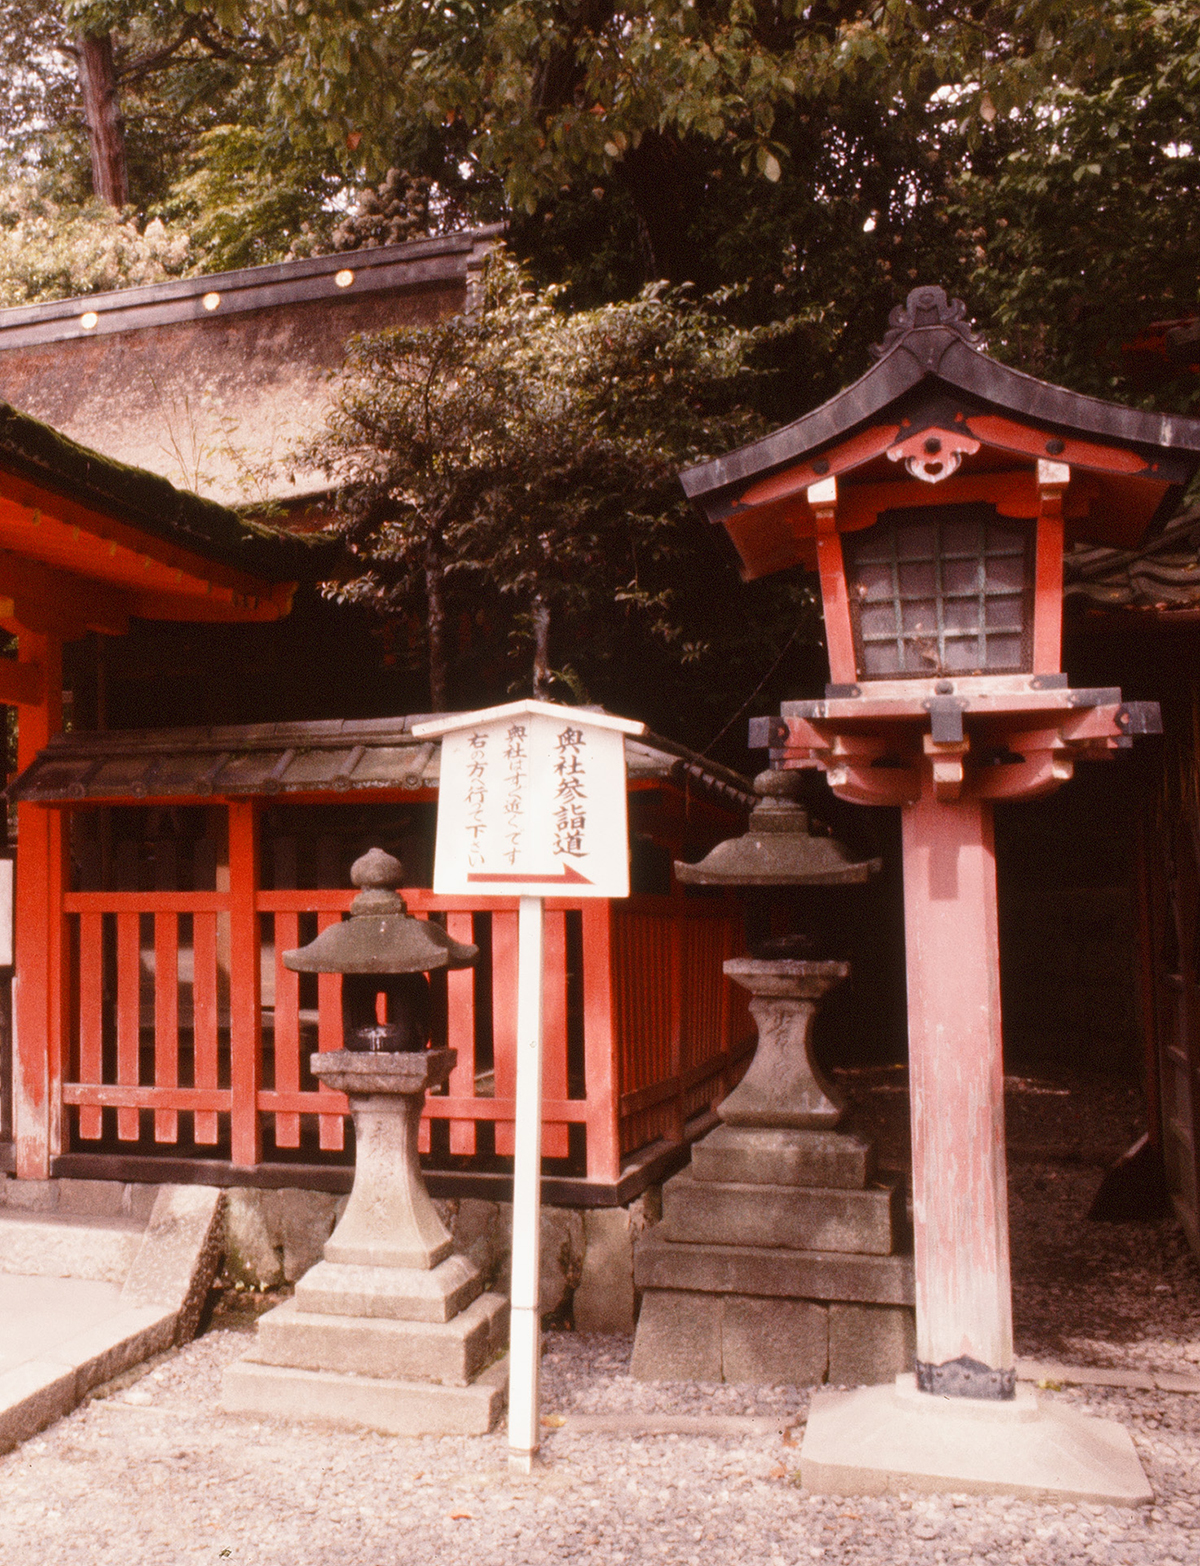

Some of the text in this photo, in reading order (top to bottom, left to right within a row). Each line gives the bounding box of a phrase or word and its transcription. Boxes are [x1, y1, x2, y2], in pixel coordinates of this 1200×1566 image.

[464, 732, 489, 867] 右の方へ行って下さい
